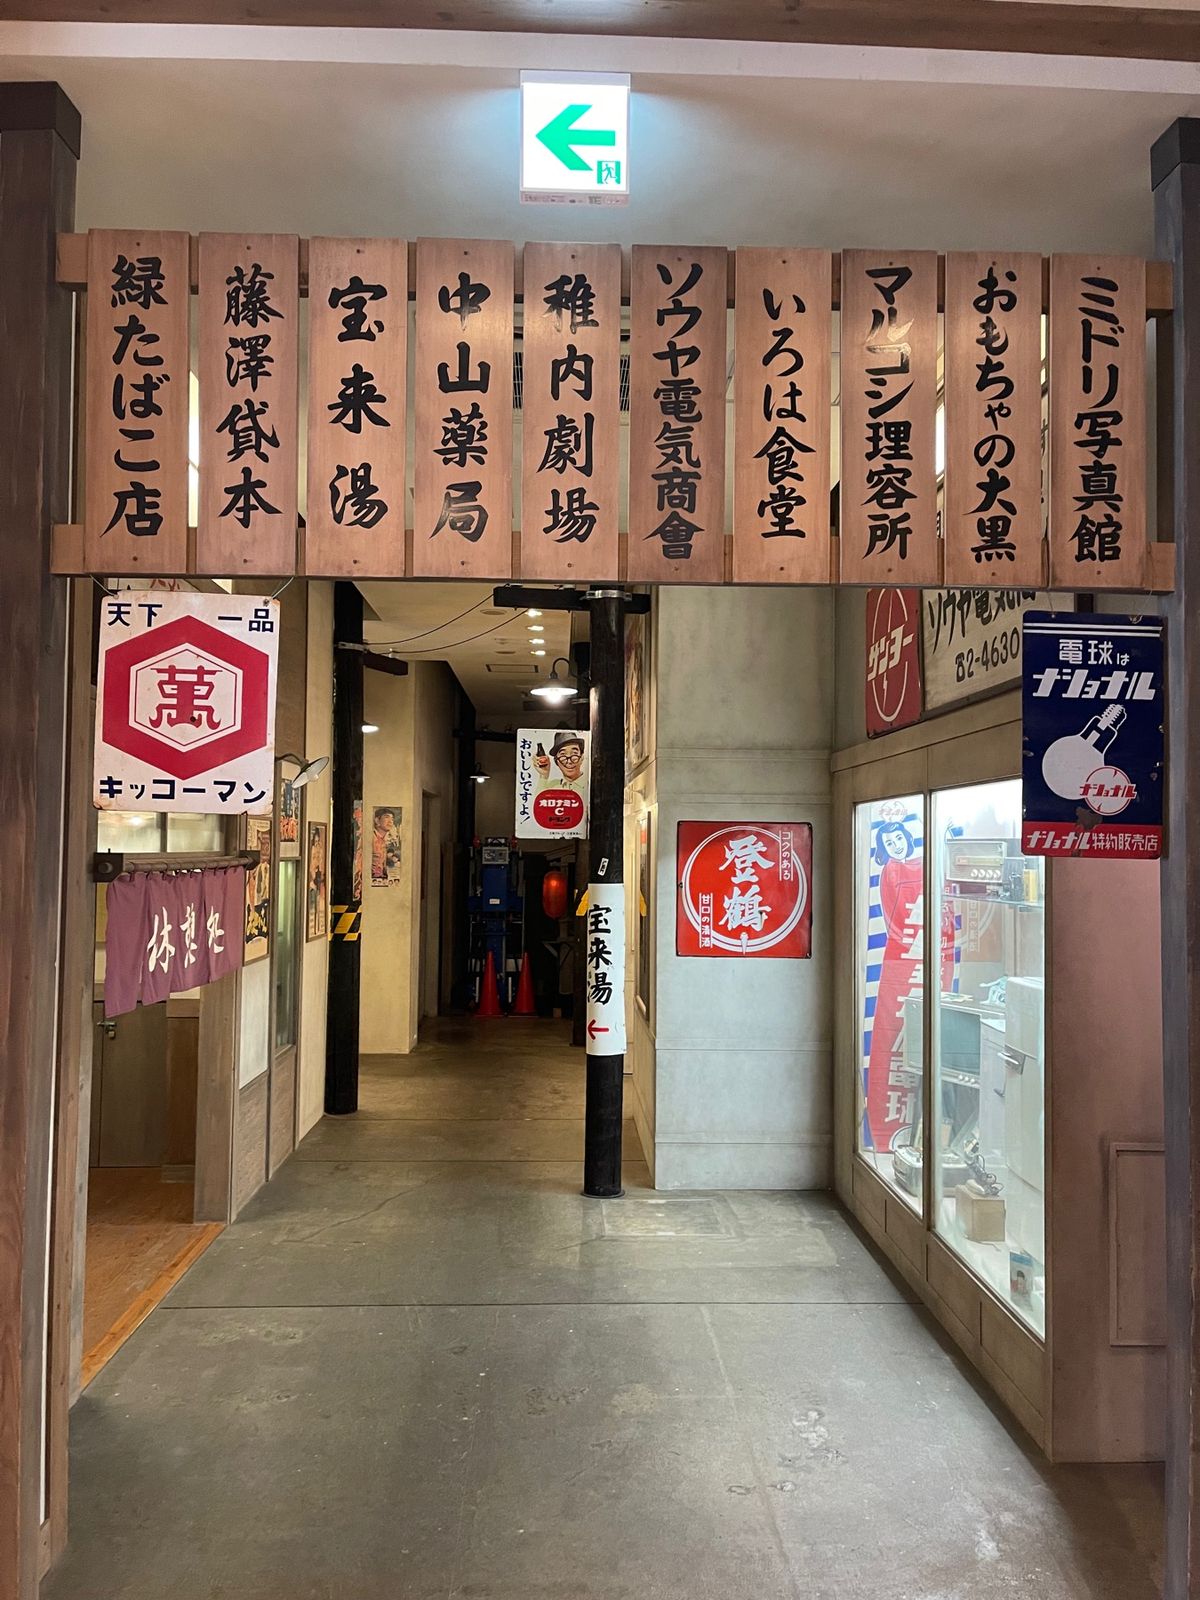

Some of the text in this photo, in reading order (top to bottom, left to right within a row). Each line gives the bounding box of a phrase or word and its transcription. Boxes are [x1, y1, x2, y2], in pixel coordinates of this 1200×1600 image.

[100, 254, 169, 537] 緑たばこ店
[216, 264, 284, 528] 藤澤貸本
[328, 276, 390, 530] 宝来湯
[429, 272, 491, 541] 中山薬局
[537, 274, 599, 543] 稚内劇場
[643, 262, 704, 560] ソウヤ電気商會
[754, 288, 817, 539] いろは食堂
[963, 266, 1017, 564] おもちゃの大黒
[1069, 276, 1124, 562] ミドリ写真館
[108, 603, 274, 632] 天下 一品
[868, 624, 914, 682] サンヨー
[1059, 639, 1130, 666] 電球は
[1032, 668, 1156, 700] ナショナル
[100, 776, 266, 804] キッコーマン
[539, 799, 579, 808] オロナミン
[554, 807, 564, 816] C
[1080, 783, 1137, 798] ナショナル
[719, 834, 776, 932] 登鶴
[781, 831, 792, 880] コクのある
[588, 904, 613, 1006] 宝来湯
